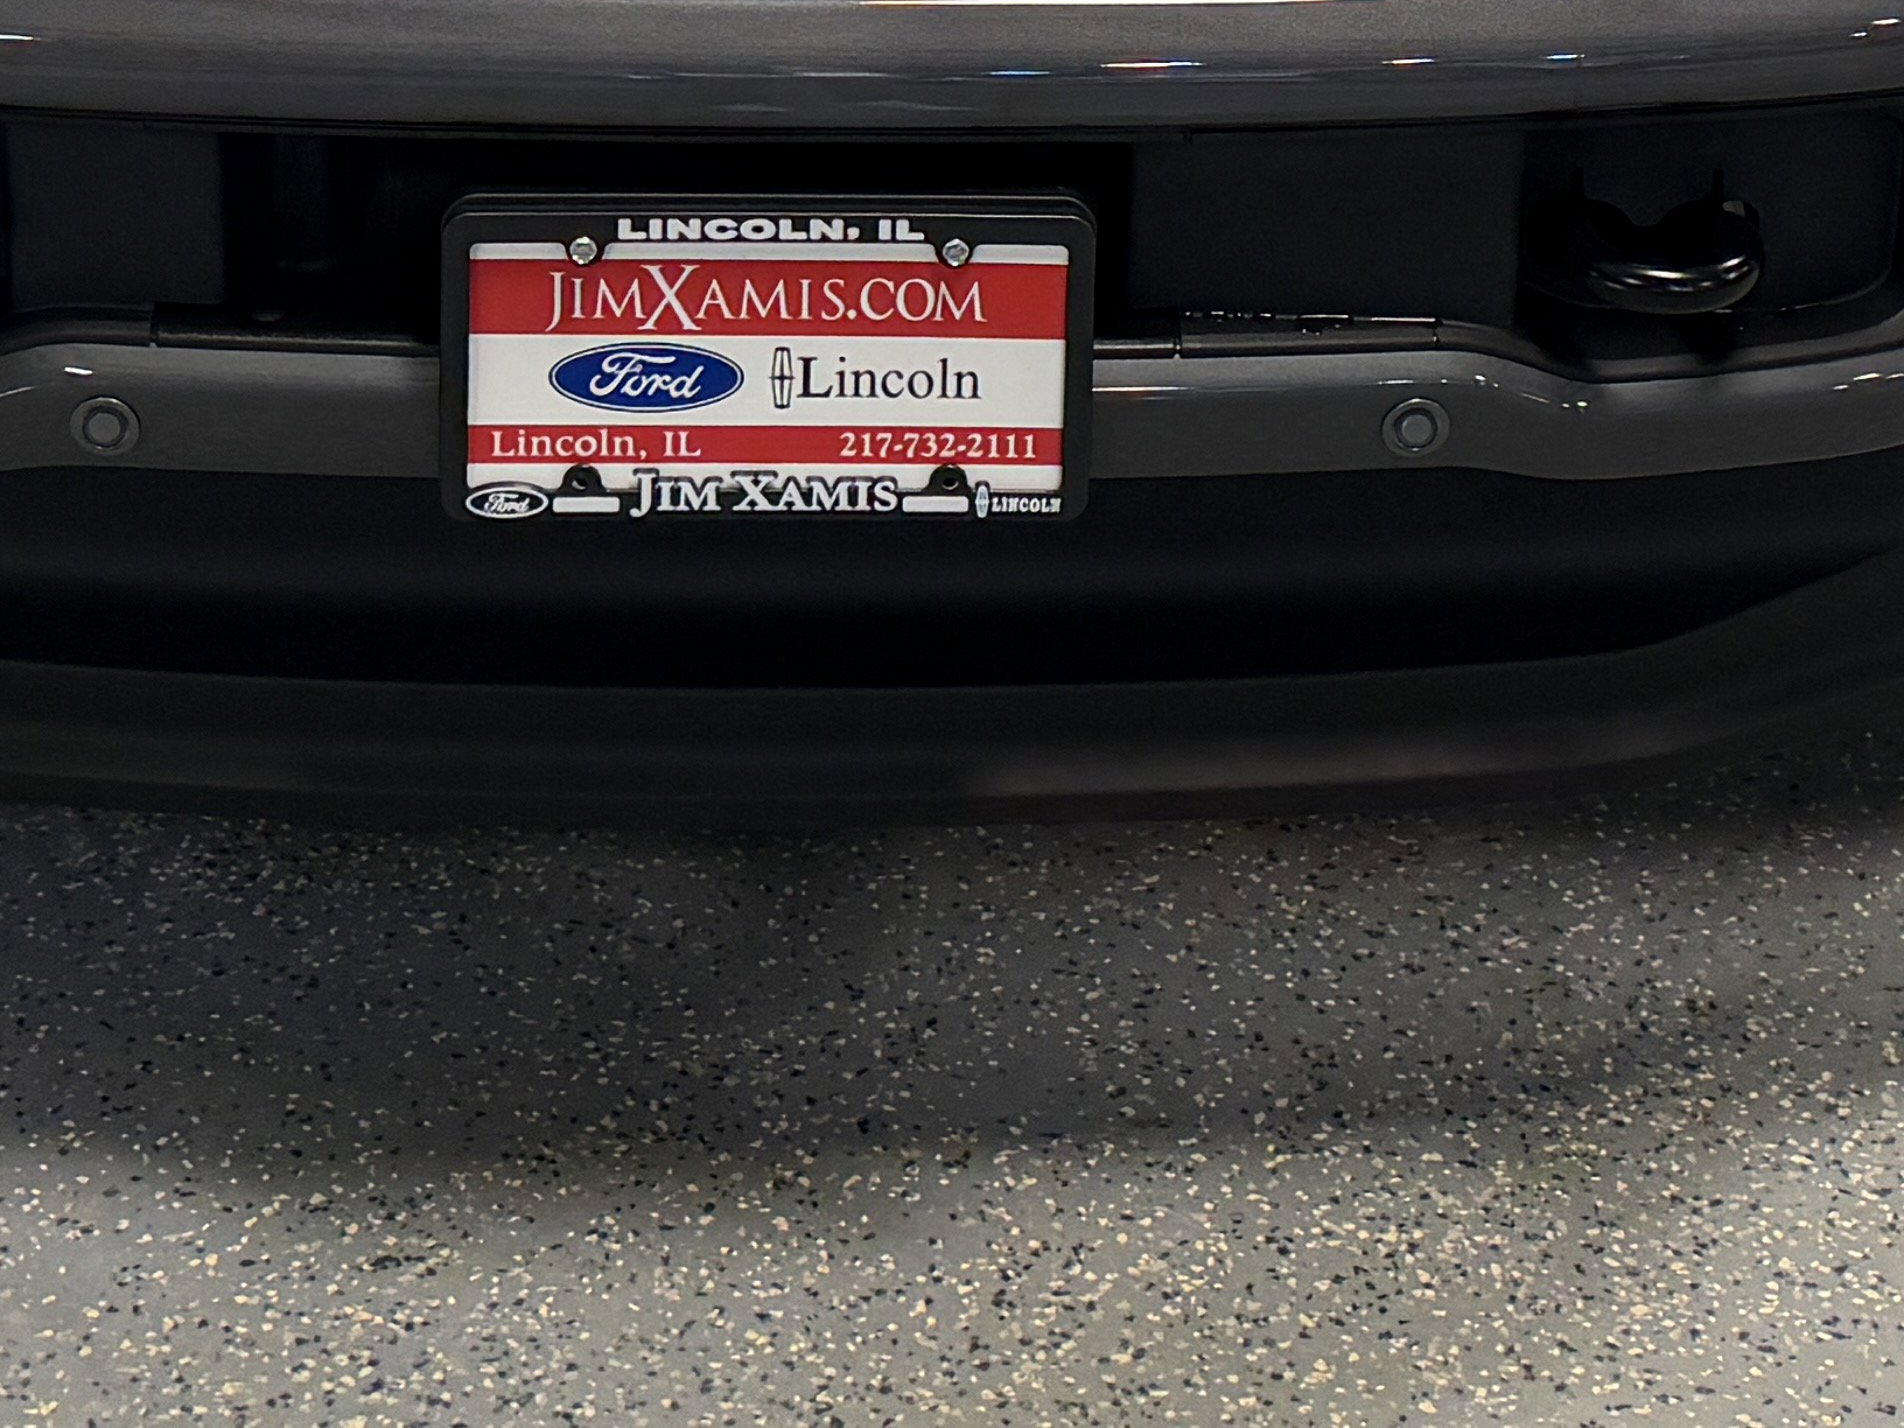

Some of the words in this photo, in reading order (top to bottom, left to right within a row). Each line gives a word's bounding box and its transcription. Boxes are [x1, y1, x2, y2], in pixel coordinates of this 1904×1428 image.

[616, 218, 860, 241] LINCOLN,
[878, 220, 926, 241] IL
[545, 264, 988, 332] JIMXAMIS.COM
[588, 351, 705, 399] Ford
[796, 357, 983, 400] Lincoln
[491, 430, 647, 460] Lincoln,
[663, 431, 702, 457] IL
[839, 431, 1037, 459] 217-732-2111
[483, 492, 531, 514] Ford
[629, 467, 724, 518] JIM
[730, 469, 899, 515] XAMIS
[991, 496, 1062, 513] LINCOLN
